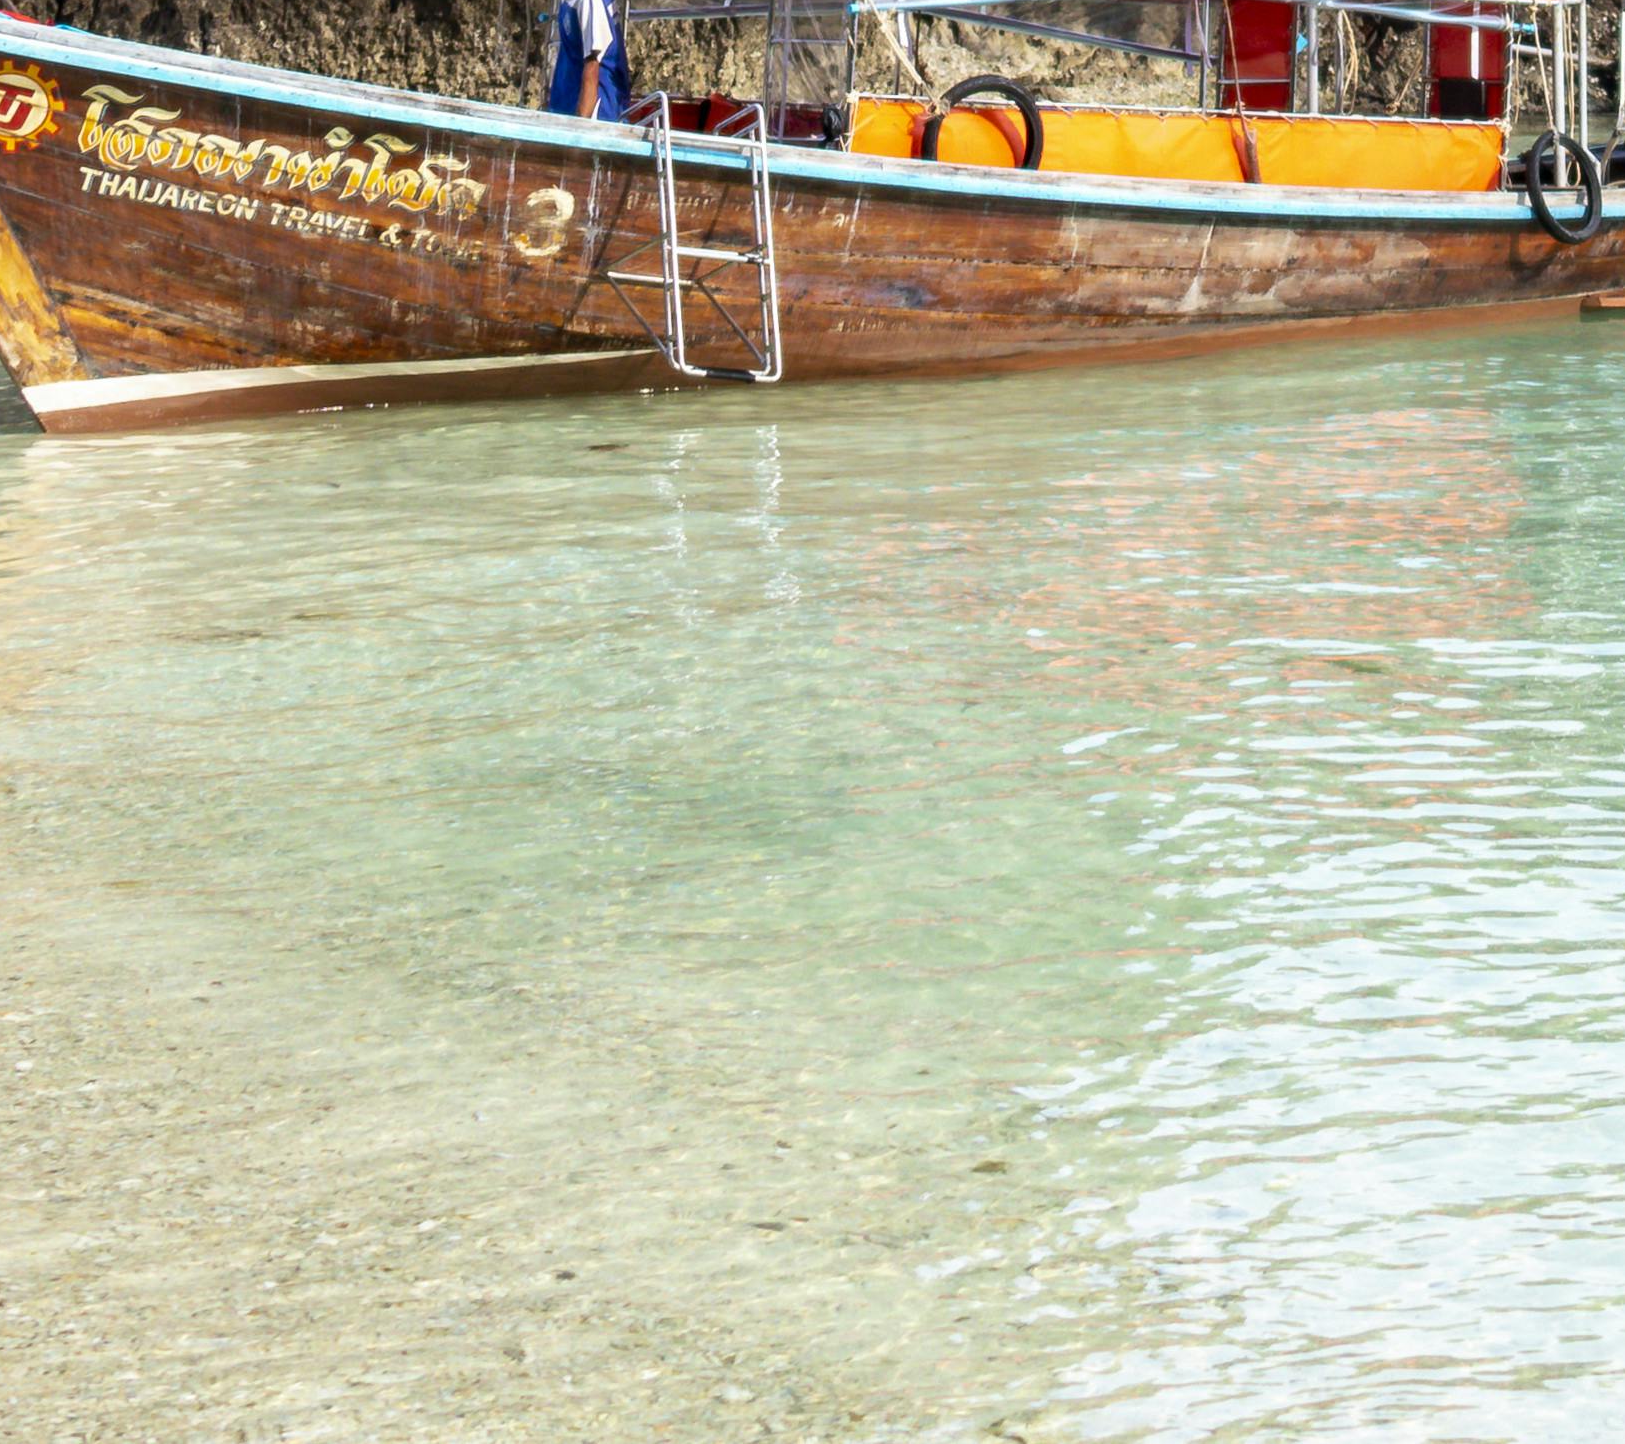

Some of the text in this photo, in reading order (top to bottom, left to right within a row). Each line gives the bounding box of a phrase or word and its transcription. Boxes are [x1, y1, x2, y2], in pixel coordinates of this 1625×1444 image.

[79, 166, 260, 221] THAIJAREON
[270, 202, 374, 241] TRAVEL
[378, 223, 403, 248] &
[510, 185, 575, 257] 3
